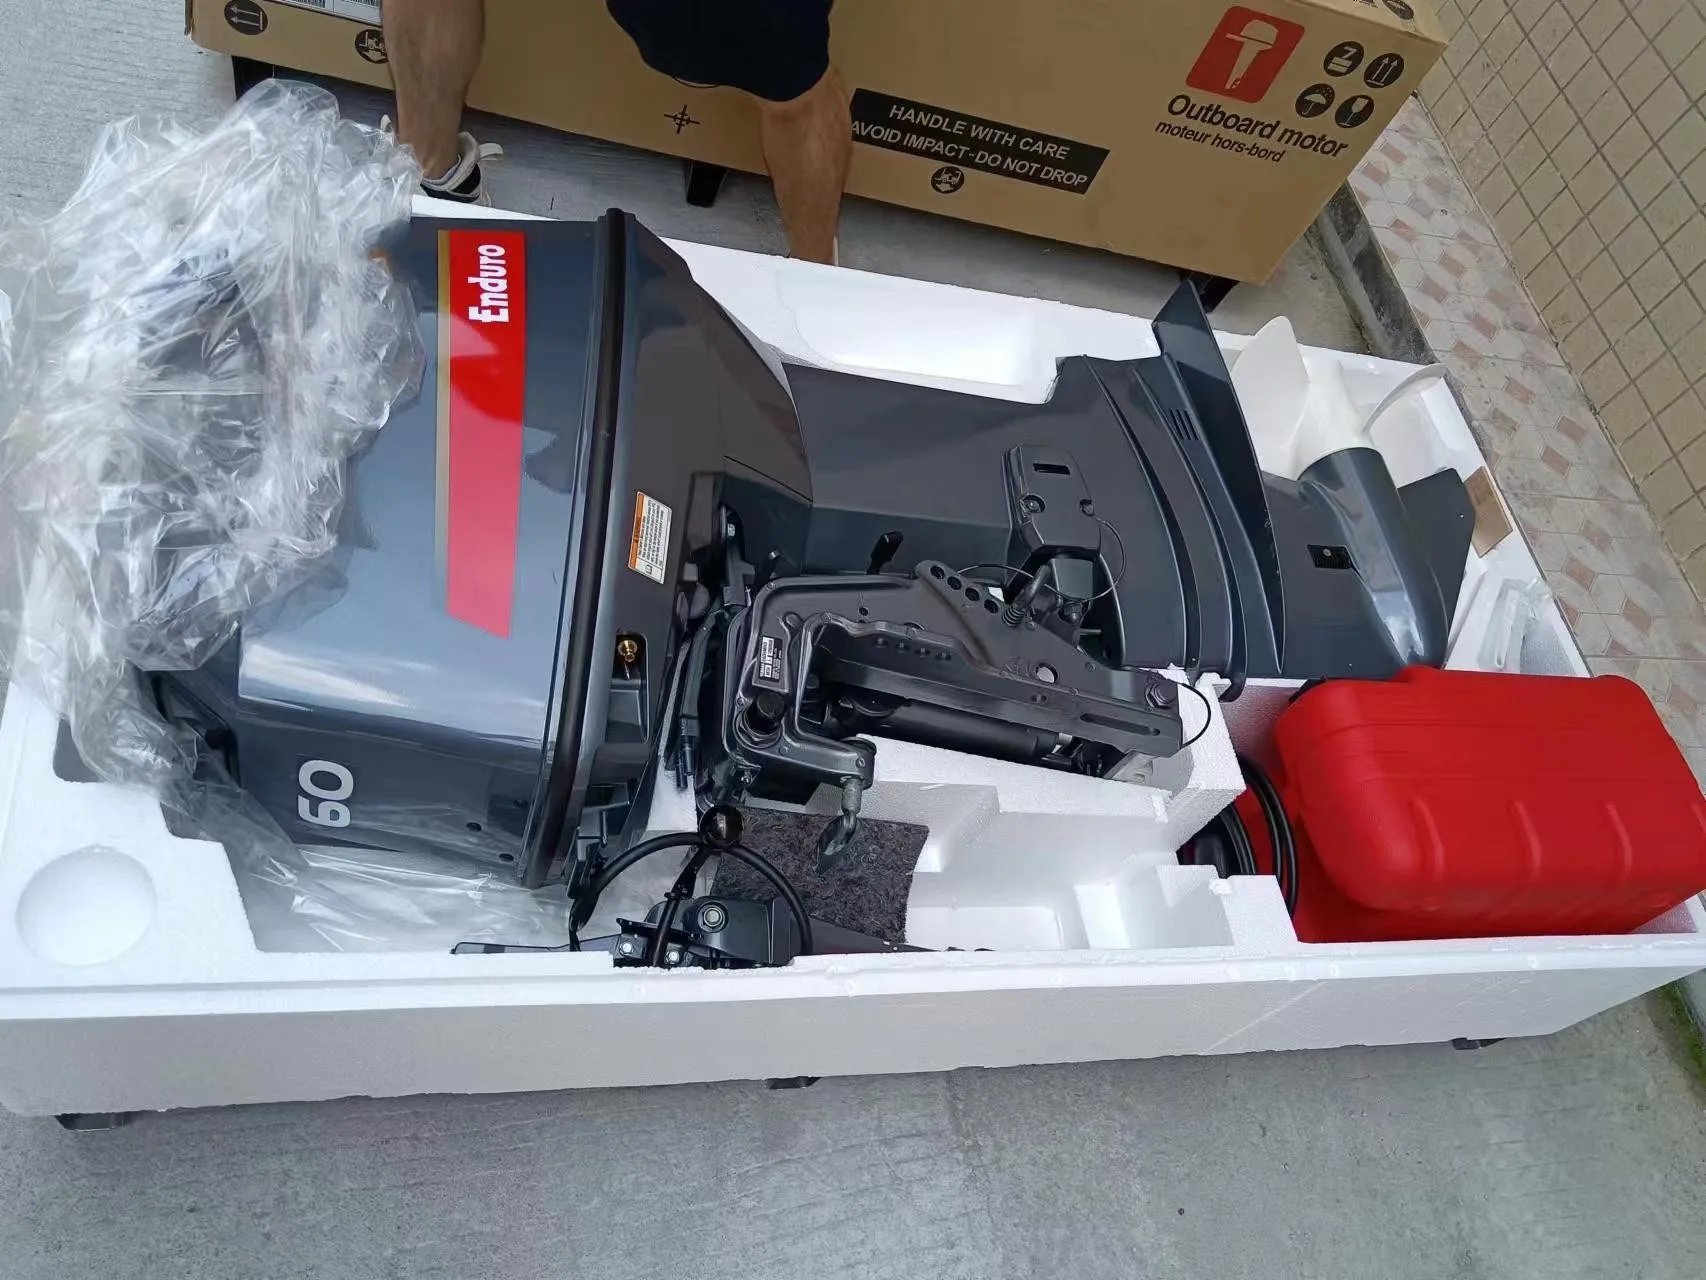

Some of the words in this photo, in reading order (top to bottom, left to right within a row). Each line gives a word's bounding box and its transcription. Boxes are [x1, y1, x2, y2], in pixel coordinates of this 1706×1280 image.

[851, 120, 902, 143] AVOID
[1003, 156, 1039, 178] NOT
[1040, 167, 1088, 188] DROP
[889, 104, 967, 136] HANDLE
[970, 124, 1016, 148] WITH
[1019, 137, 1071, 161] CARE
[1155, 121, 1212, 144] moteur
[1210, 133, 1287, 163] hors-bord
[1167, 94, 1281, 140] Outboard
[1277, 126, 1349, 158] motor
[467, 244, 509, 323] Enduro
[298, 760, 354, 828] 60
